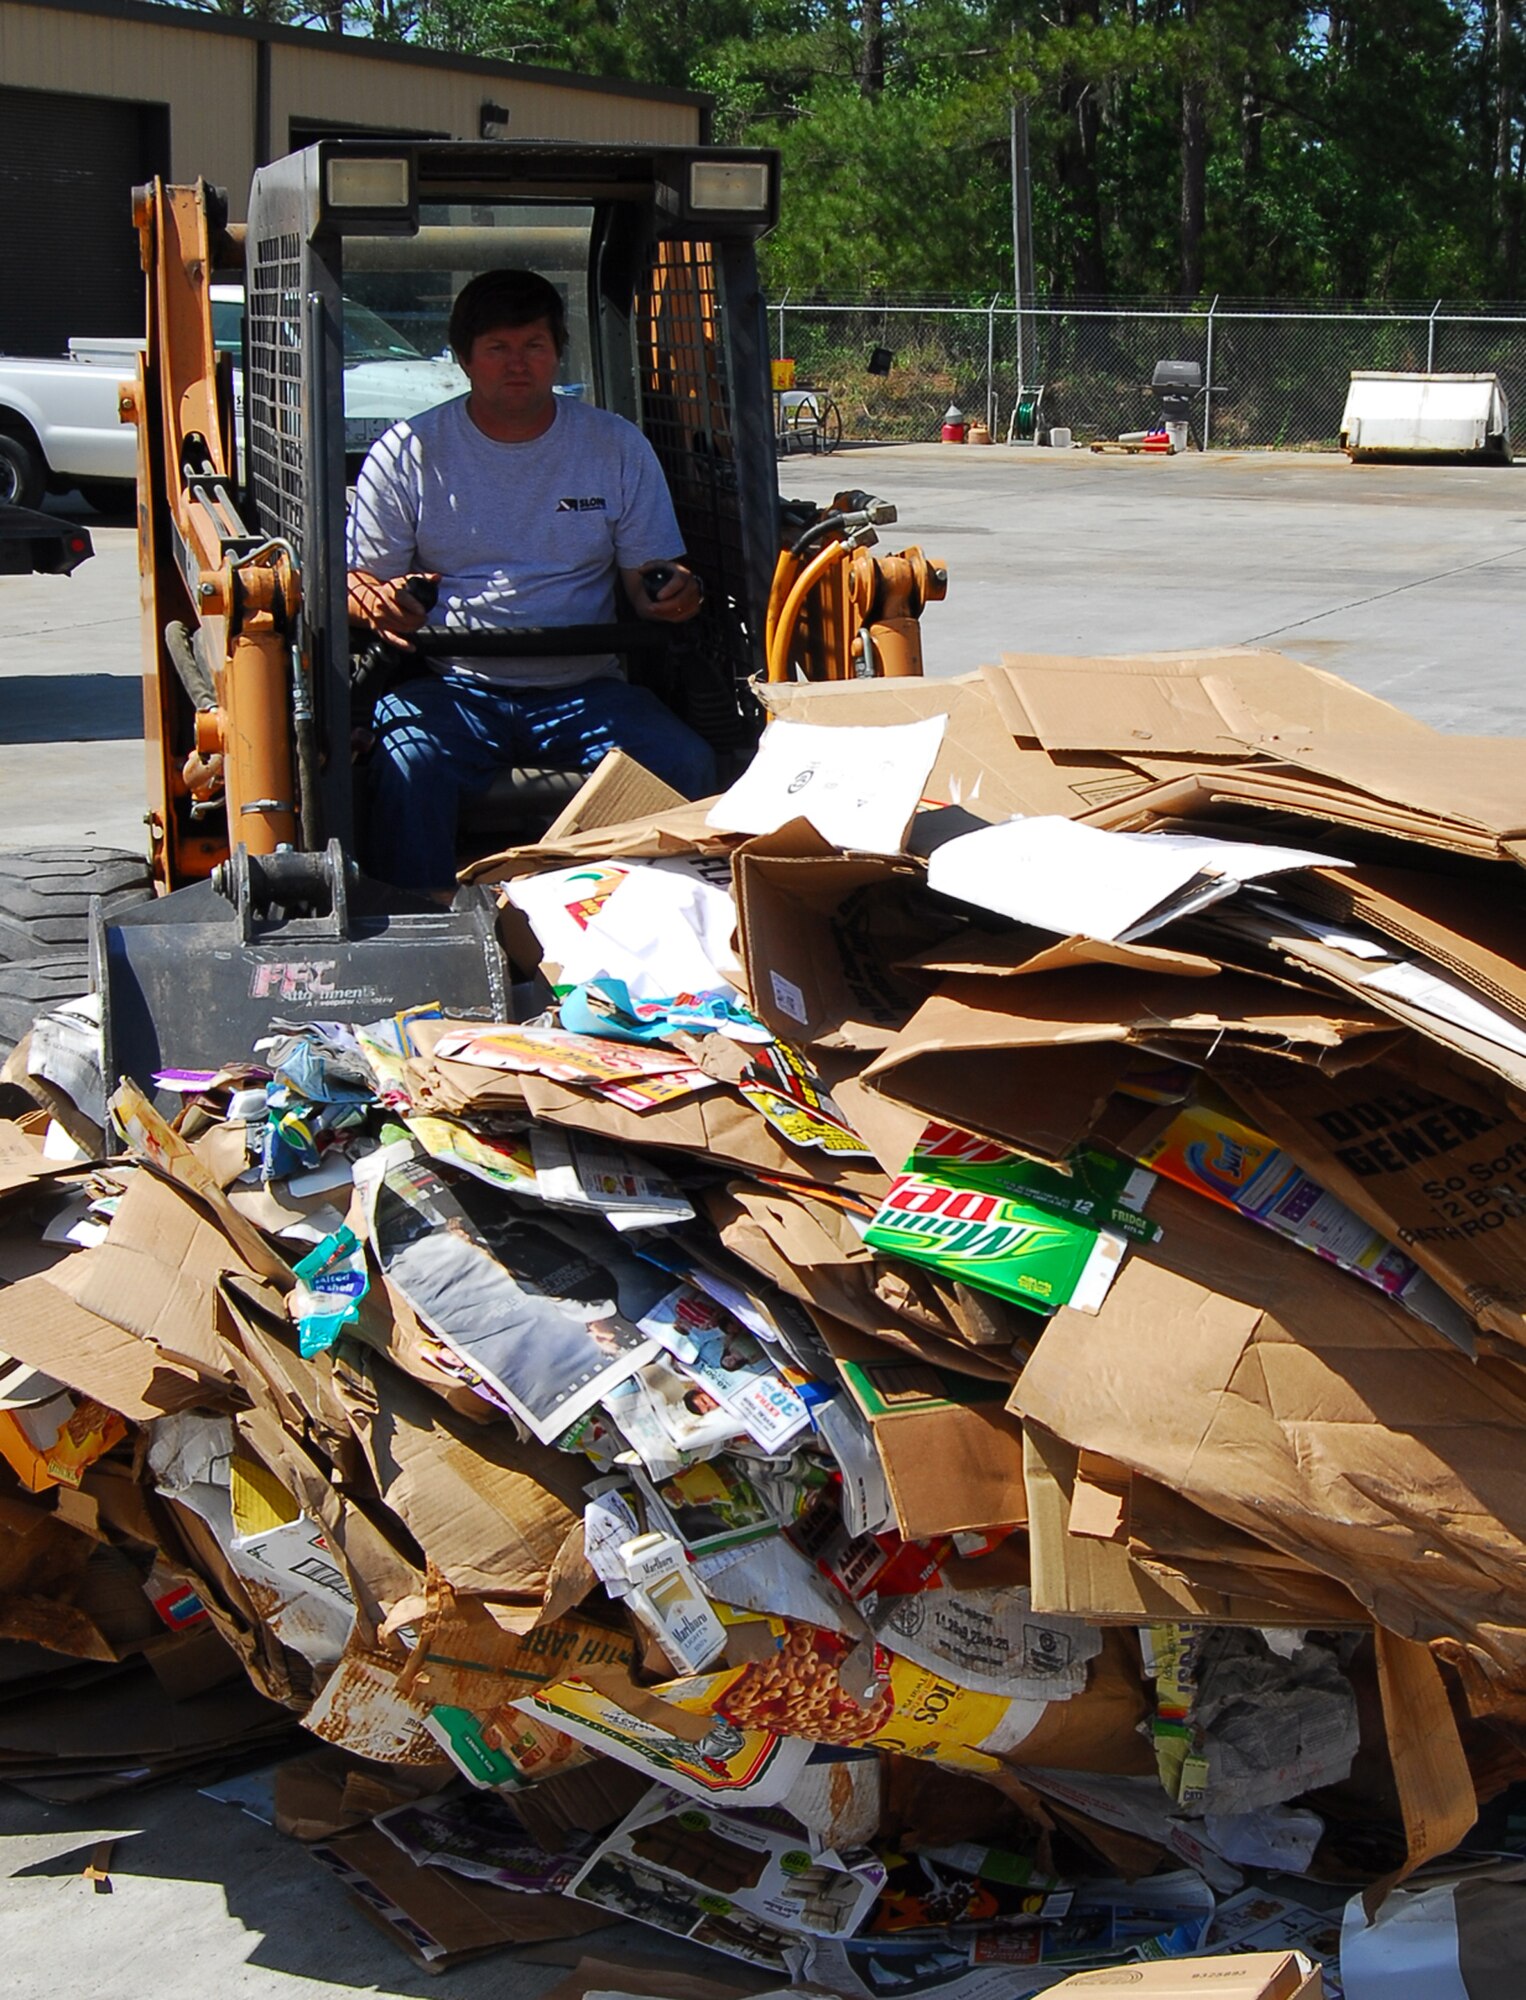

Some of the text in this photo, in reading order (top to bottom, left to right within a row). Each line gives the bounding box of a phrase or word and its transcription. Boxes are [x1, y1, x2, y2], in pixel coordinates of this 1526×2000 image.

[252, 959, 336, 998] FFC
[281, 985, 377, 1002] Attahments
[1317, 1090, 1453, 1142] DOLL
[1334, 1105, 1504, 1177] GENER
[1423, 1176, 1466, 1200] So
[1073, 1198, 1096, 1213] 12
[1110, 1207, 1149, 1230] FRIDGE
[326, 1281, 355, 1292] shell
[754, 1391, 781, 1418] EXTRA
[642, 1554, 674, 1575] Marlboro
[837, 1533, 869, 1573] DUTY
[844, 1543, 882, 1590] HEAVY
[671, 1612, 709, 1643] Marlboro
